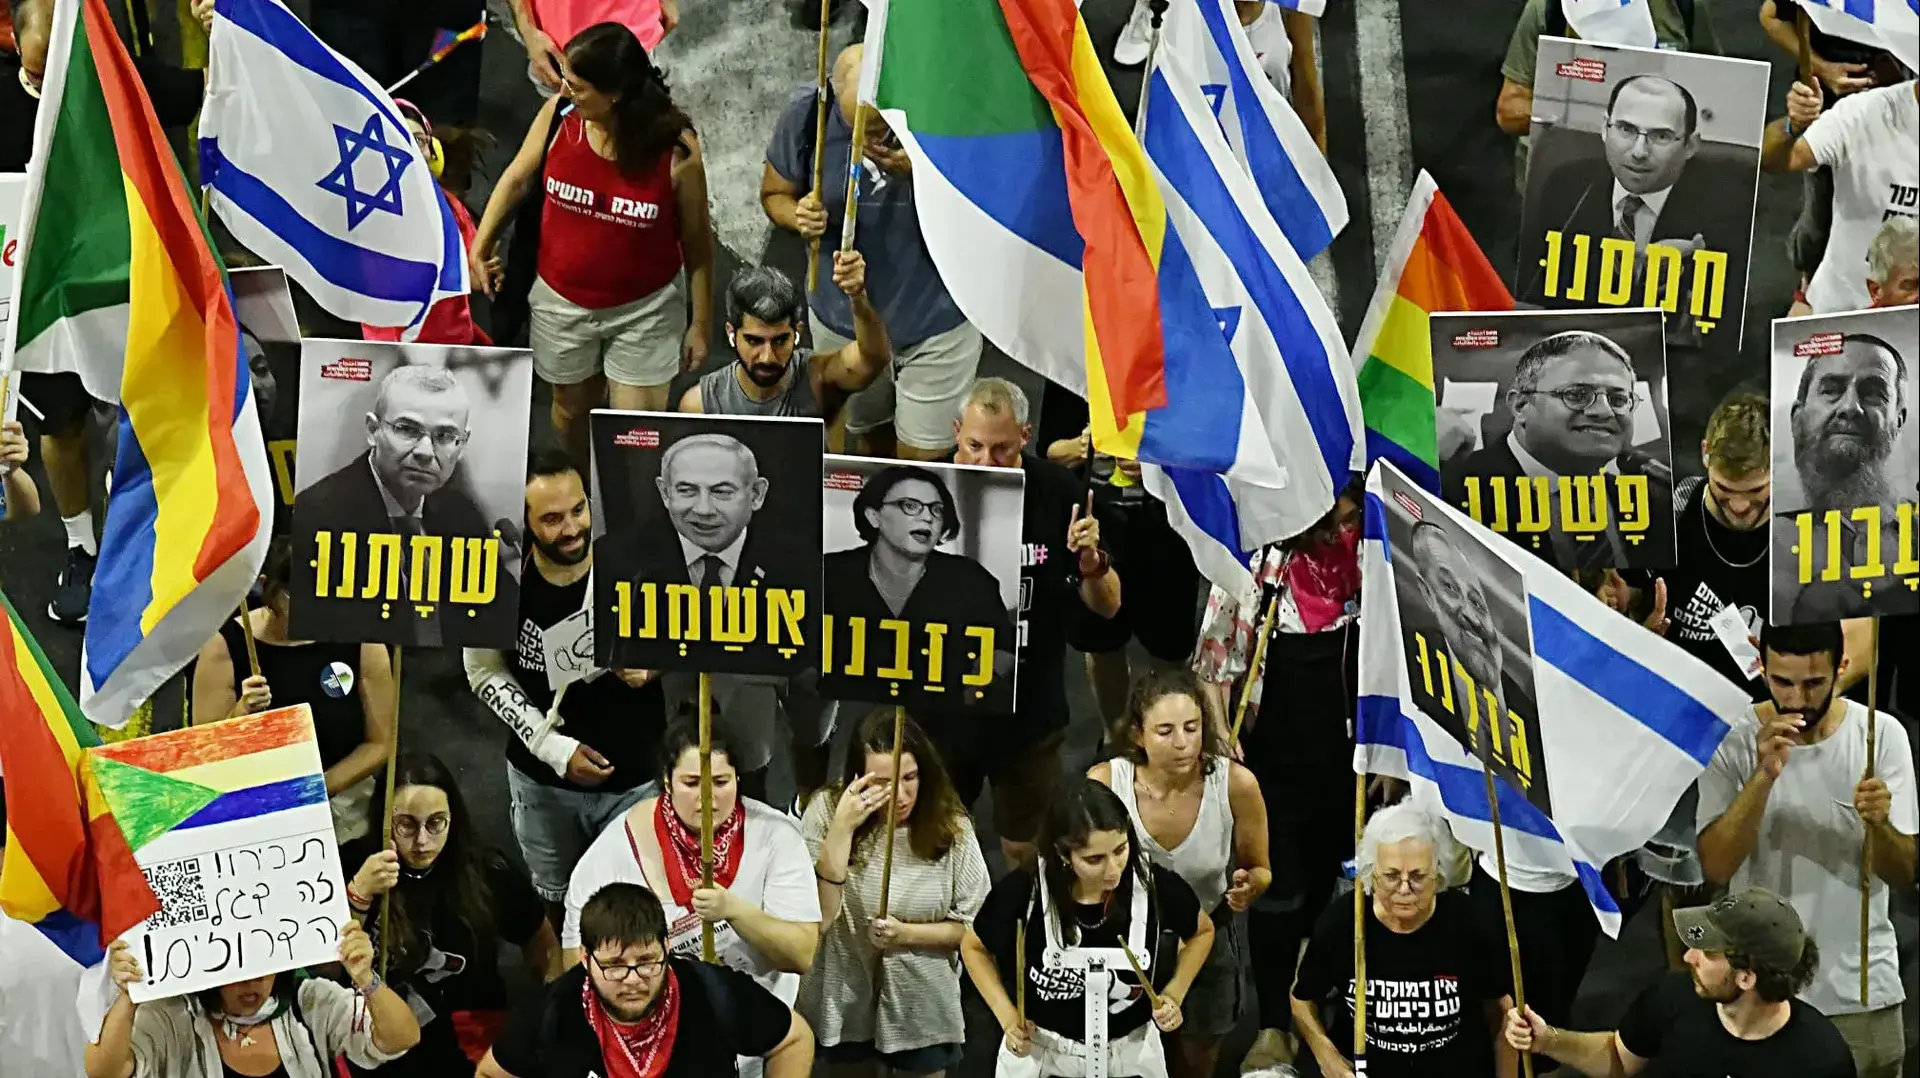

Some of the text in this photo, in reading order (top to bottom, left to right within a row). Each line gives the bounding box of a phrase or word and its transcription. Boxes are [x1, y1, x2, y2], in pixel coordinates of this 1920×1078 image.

[546, 176, 659, 220] מאבק הנשים
[499, 681, 536, 712] FCK
[214, 838, 326, 878] תכירו!
[211, 871, 334, 927] זה דגל
[143, 916, 339, 986] הדרוזים!
[1348, 979, 1459, 1001] אין דמוקרטה
[1375, 996, 1461, 1018] עם כיבוש
[1377, 1039, 1418, 1054] לכיבוש
